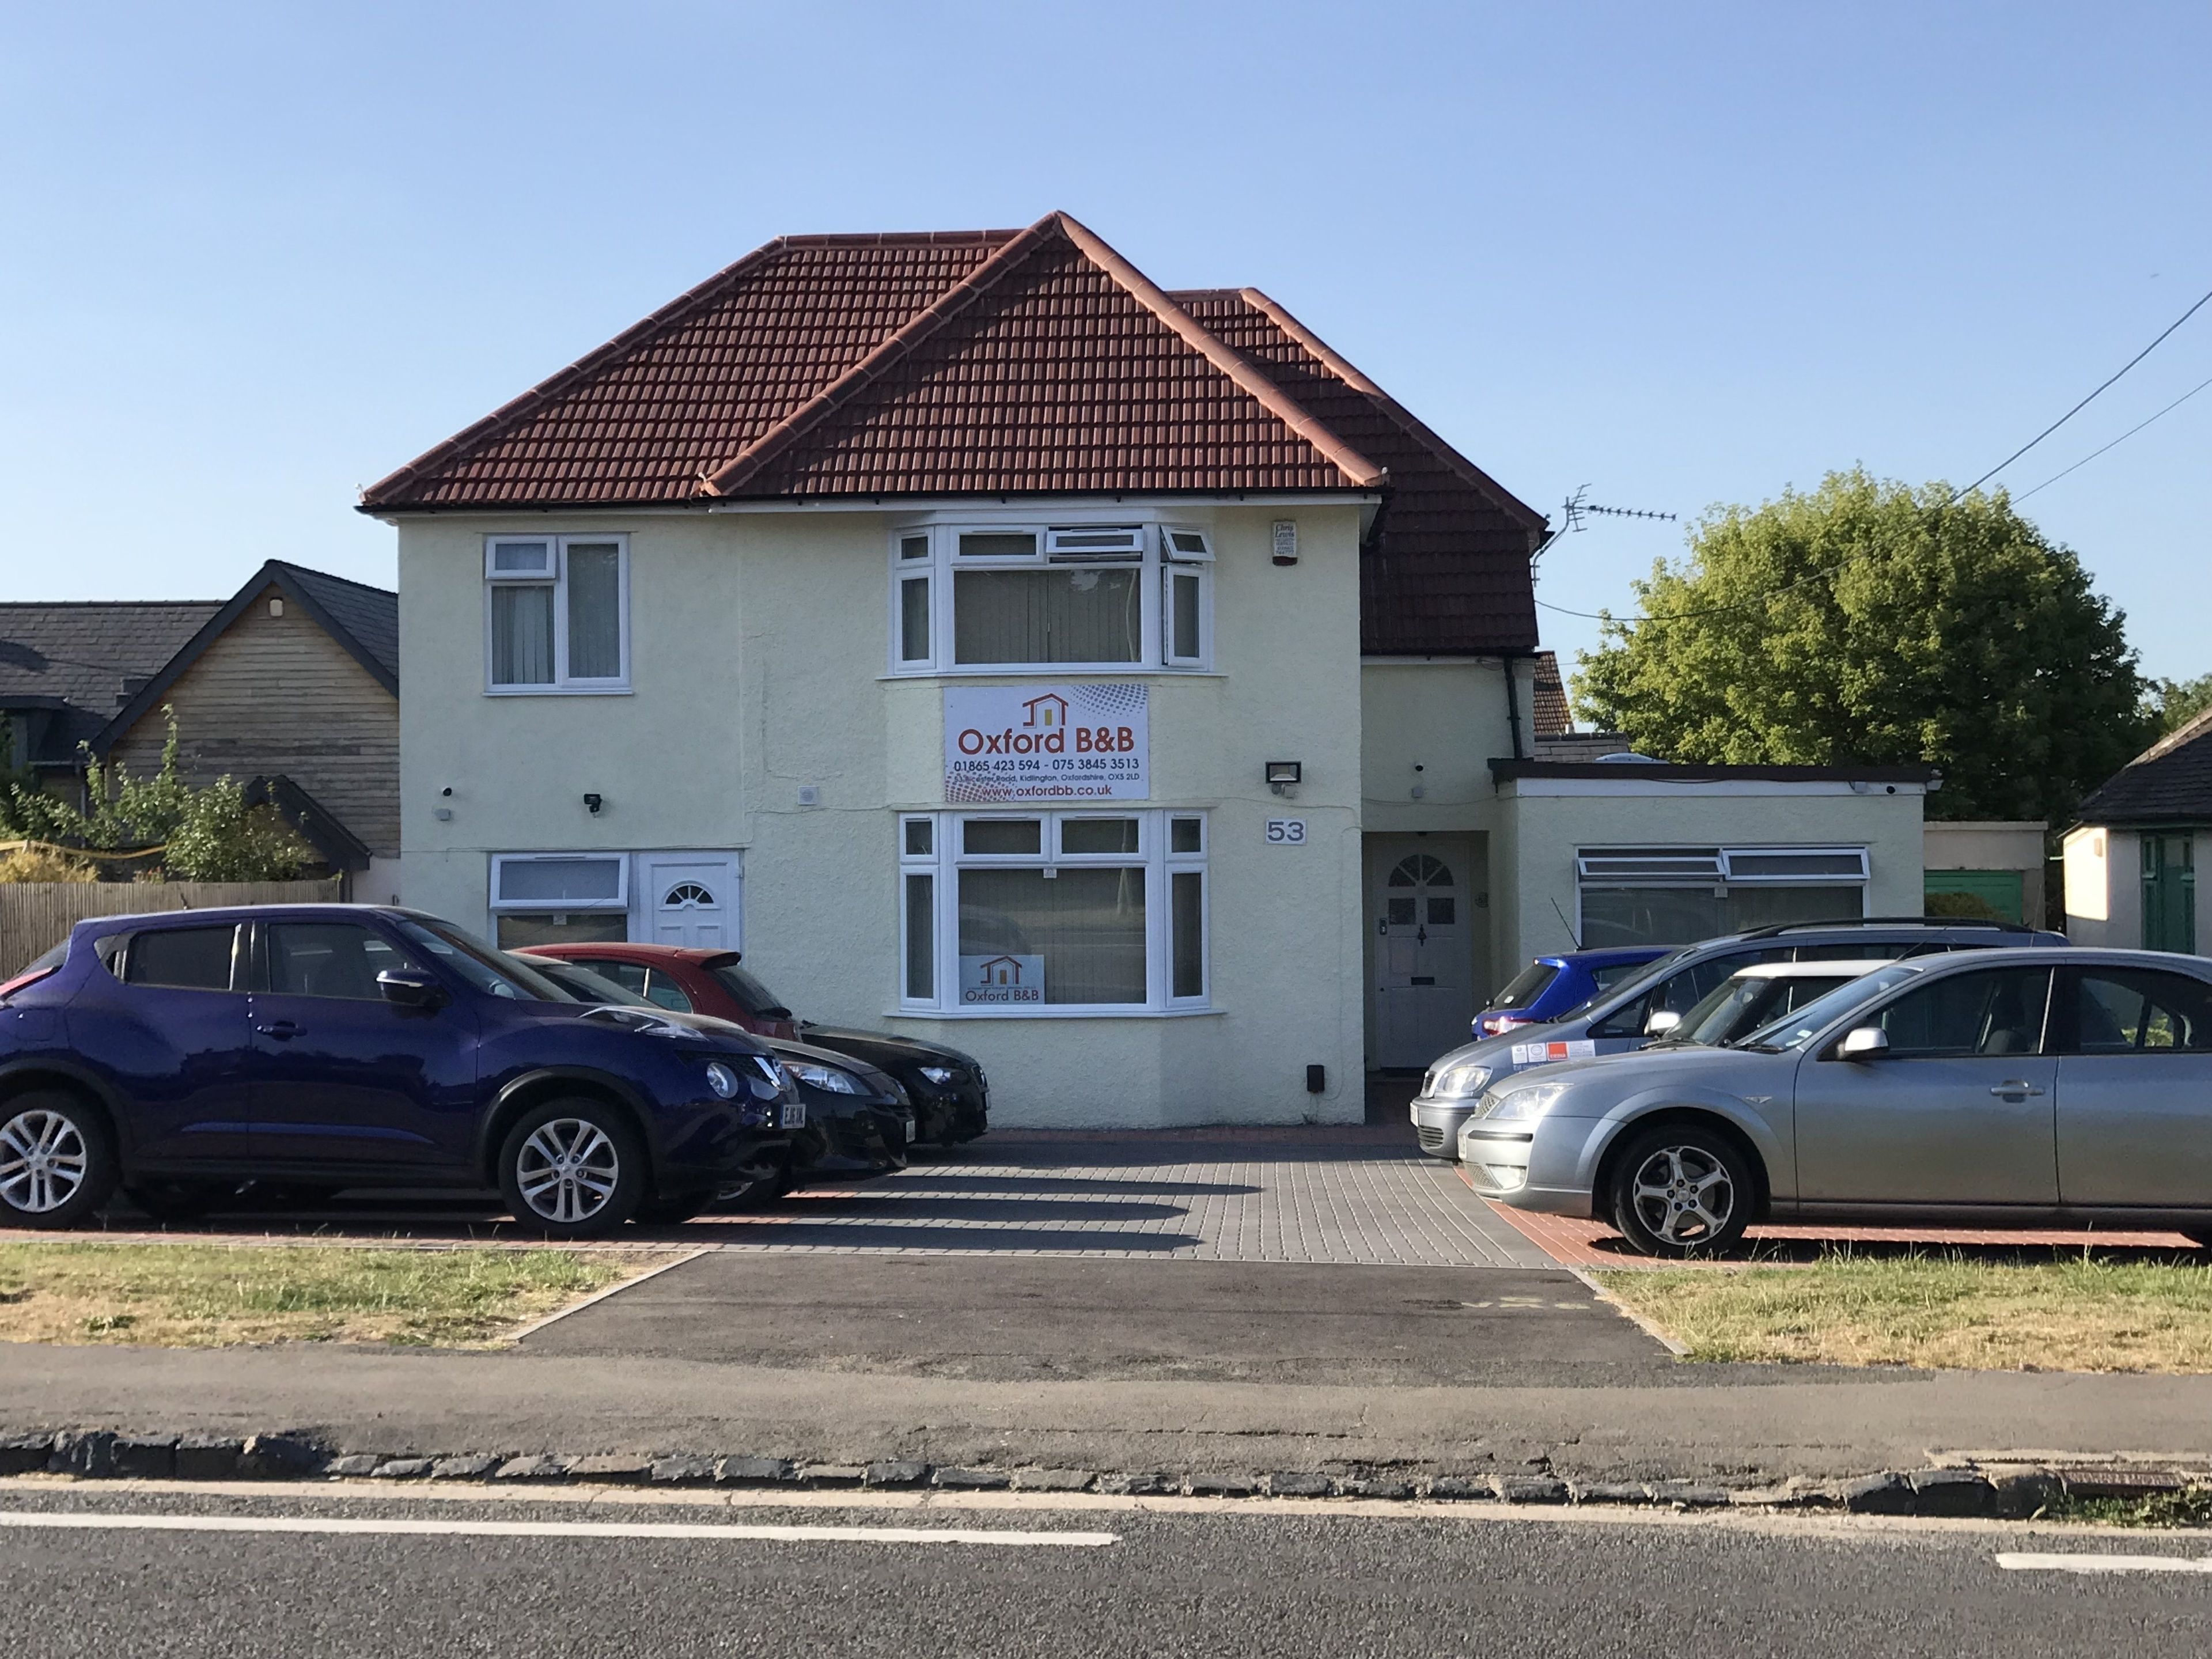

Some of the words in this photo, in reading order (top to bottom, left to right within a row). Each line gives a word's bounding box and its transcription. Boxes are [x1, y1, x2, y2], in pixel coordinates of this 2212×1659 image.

[958, 728, 1065, 755] Oxford
[1075, 726, 1134, 753] B&B
[954, 760, 990, 772] 01865
[993, 760, 1015, 771] 423
[1018, 760, 1040, 771] 594
[1052, 759, 1074, 770] 075
[1078, 758, 1107, 770] 3845
[1110, 758, 1139, 770] 3513
[1020, 774, 1059, 783] Kidlington,
[982, 785, 1112, 797] www.oxfordbb.co.uk
[1268, 821, 1304, 842] 53
[965, 990, 1009, 1001] Oxford
[1014, 990, 1039, 1001] B&B
